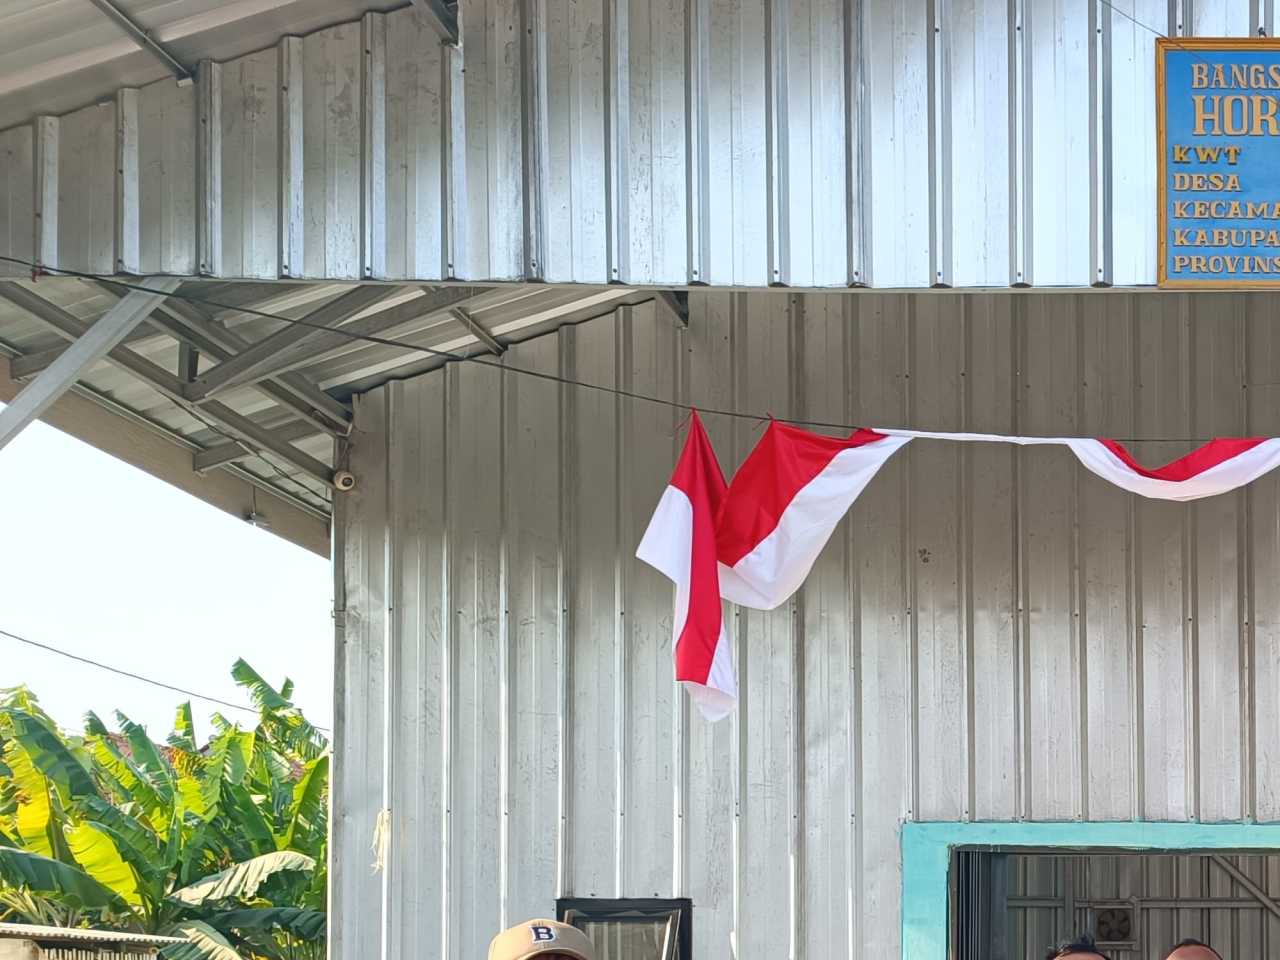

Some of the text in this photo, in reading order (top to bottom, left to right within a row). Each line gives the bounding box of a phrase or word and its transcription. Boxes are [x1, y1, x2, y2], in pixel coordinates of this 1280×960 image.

[1173, 144, 1242, 165] KWT
[1173, 173, 1242, 192] DESA
[530, 926, 555, 943] B
